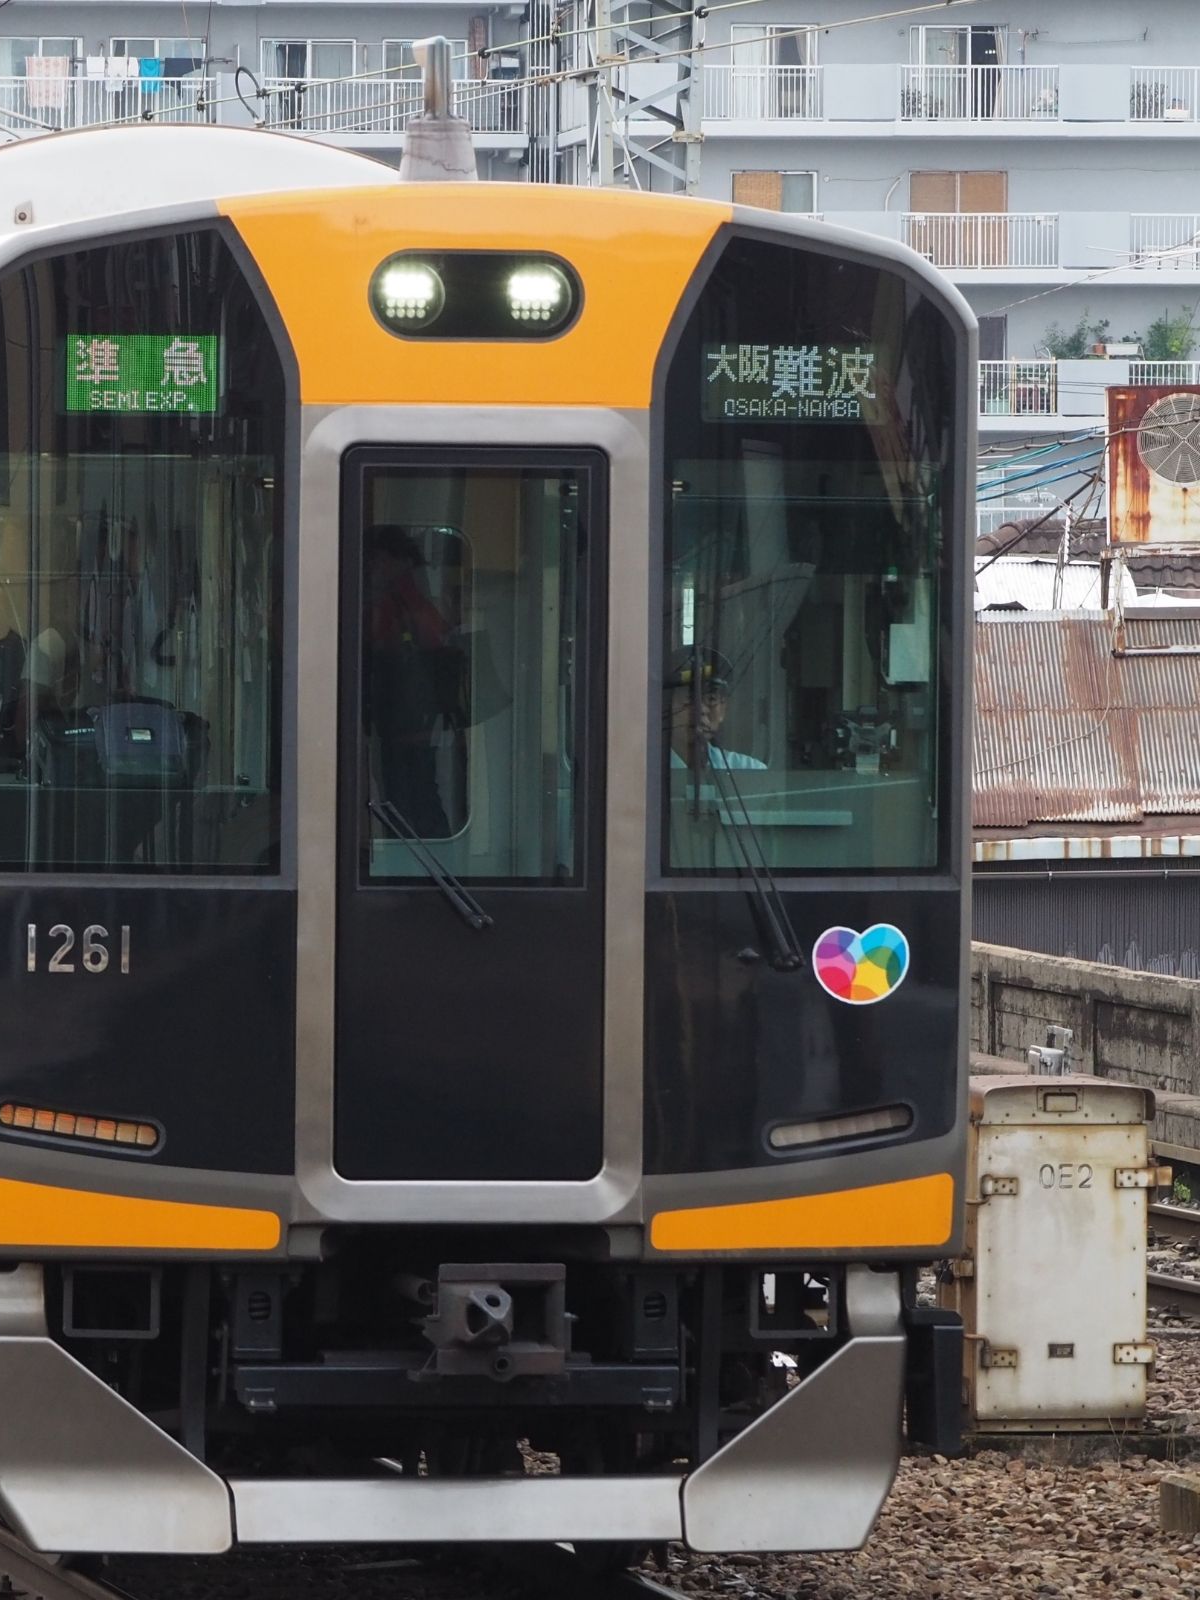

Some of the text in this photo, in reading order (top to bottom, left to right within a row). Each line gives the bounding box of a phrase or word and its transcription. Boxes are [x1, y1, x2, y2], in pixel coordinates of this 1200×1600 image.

[76, 338, 207, 386] 準急
[707, 344, 876, 399] 大阪難波
[90, 391, 195, 410] SEMI EXP.
[724, 398, 861, 418] OSAKA-NAMBA
[27, 923, 130, 974] 1261
